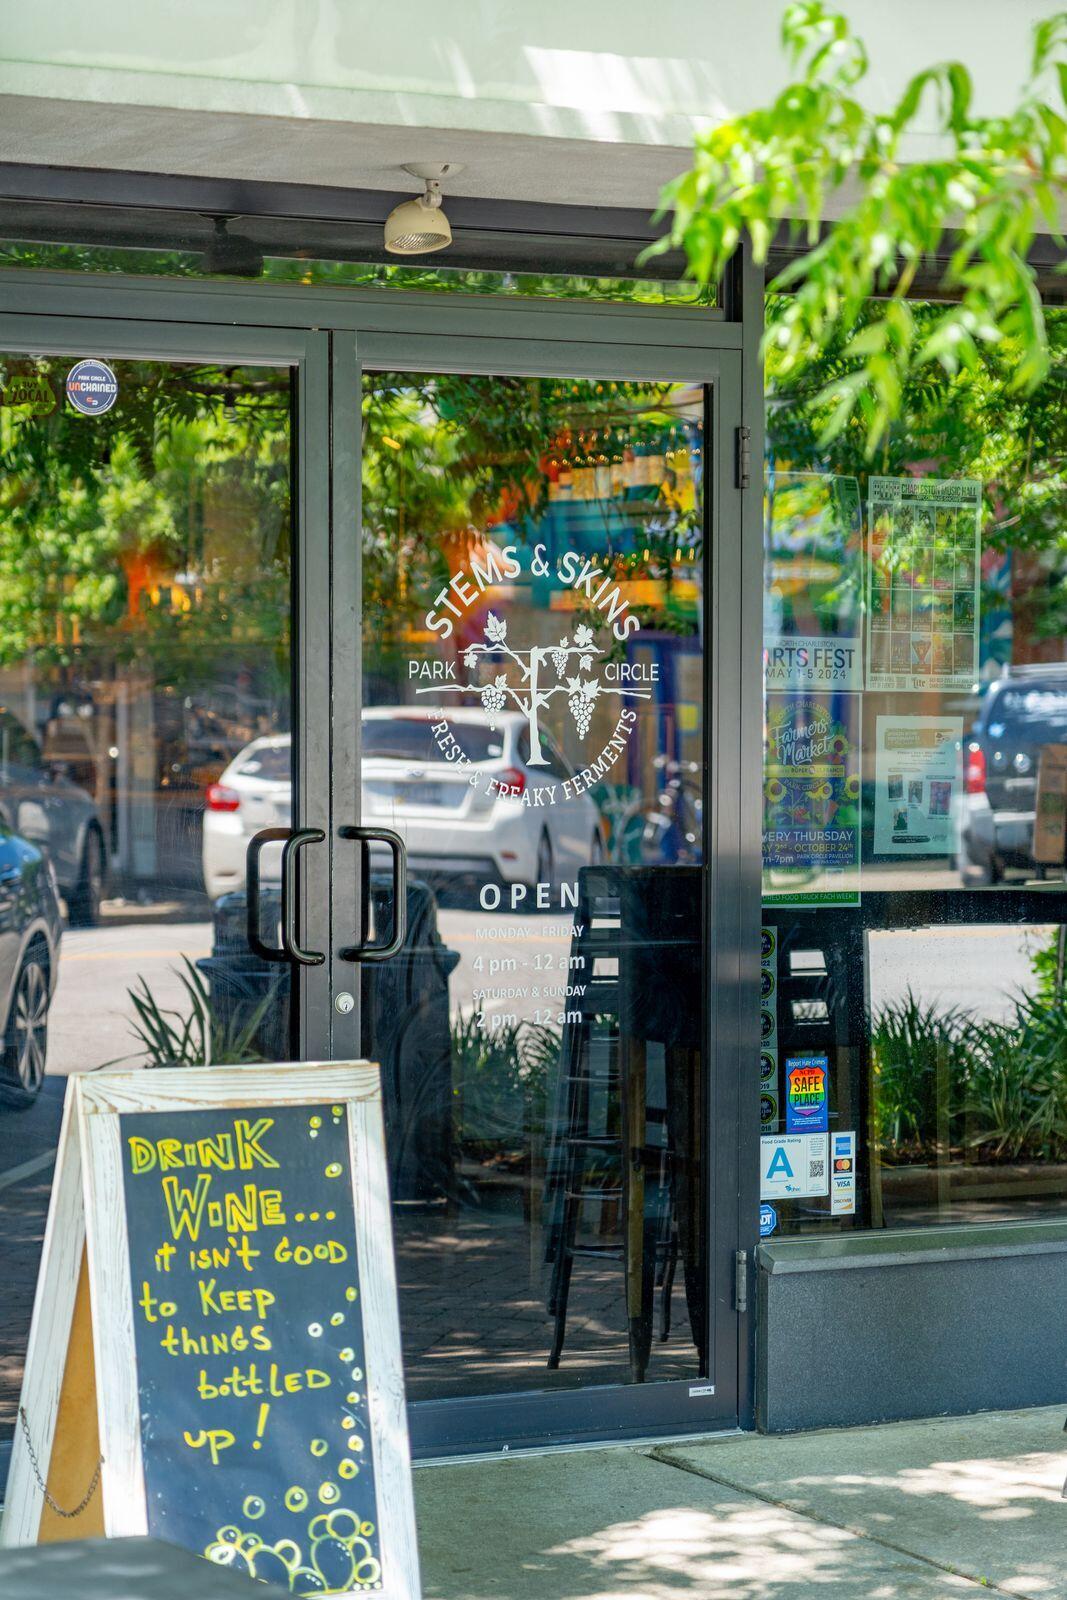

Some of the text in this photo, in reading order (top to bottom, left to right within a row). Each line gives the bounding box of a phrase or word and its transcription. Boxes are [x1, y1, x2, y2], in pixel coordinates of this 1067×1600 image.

[68, 382, 117, 393] UNCHAINED
[425, 543, 640, 640] STEMS & SKINS
[814, 648, 855, 669] FEST
[408, 660, 659, 681] PARK CIRCLE
[765, 669, 793, 678] MAY
[818, 669, 847, 679] 2024
[769, 718, 828, 748] Farmers
[427, 707, 473, 775] FRESH
[469, 770, 485, 789] &
[485, 777, 557, 807] FREAKY
[561, 708, 637, 800] FERMENTS
[777, 734, 835, 766] Market
[793, 831, 854, 842] THURSDAY
[762, 844, 773, 852] AY
[794, 843, 836, 852] OCTOBER
[479, 882, 580, 911] OPEN
[475, 926, 530, 938] MONDAY
[542, 925, 584, 938] FRIDAY
[473, 955, 485, 972] 4
[490, 959, 517, 975] pm
[534, 954, 553, 970] 12
[559, 955, 586, 970] am
[472, 985, 587, 1000] SATURDAY & SUNDAY
[476, 1011, 486, 1028] 2
[492, 1014, 517, 1030] pm
[534, 1010, 553, 1025] 12
[557, 1011, 582, 1024] am
[794, 1076, 820, 1093] SAFE
[794, 1093, 820, 1106] PLACE
[766, 1147, 794, 1179] A
[836, 1180, 851, 1188] VISA
[274, 1236, 348, 1265] GOOD
[138, 1278, 276, 1323] to KEEP
